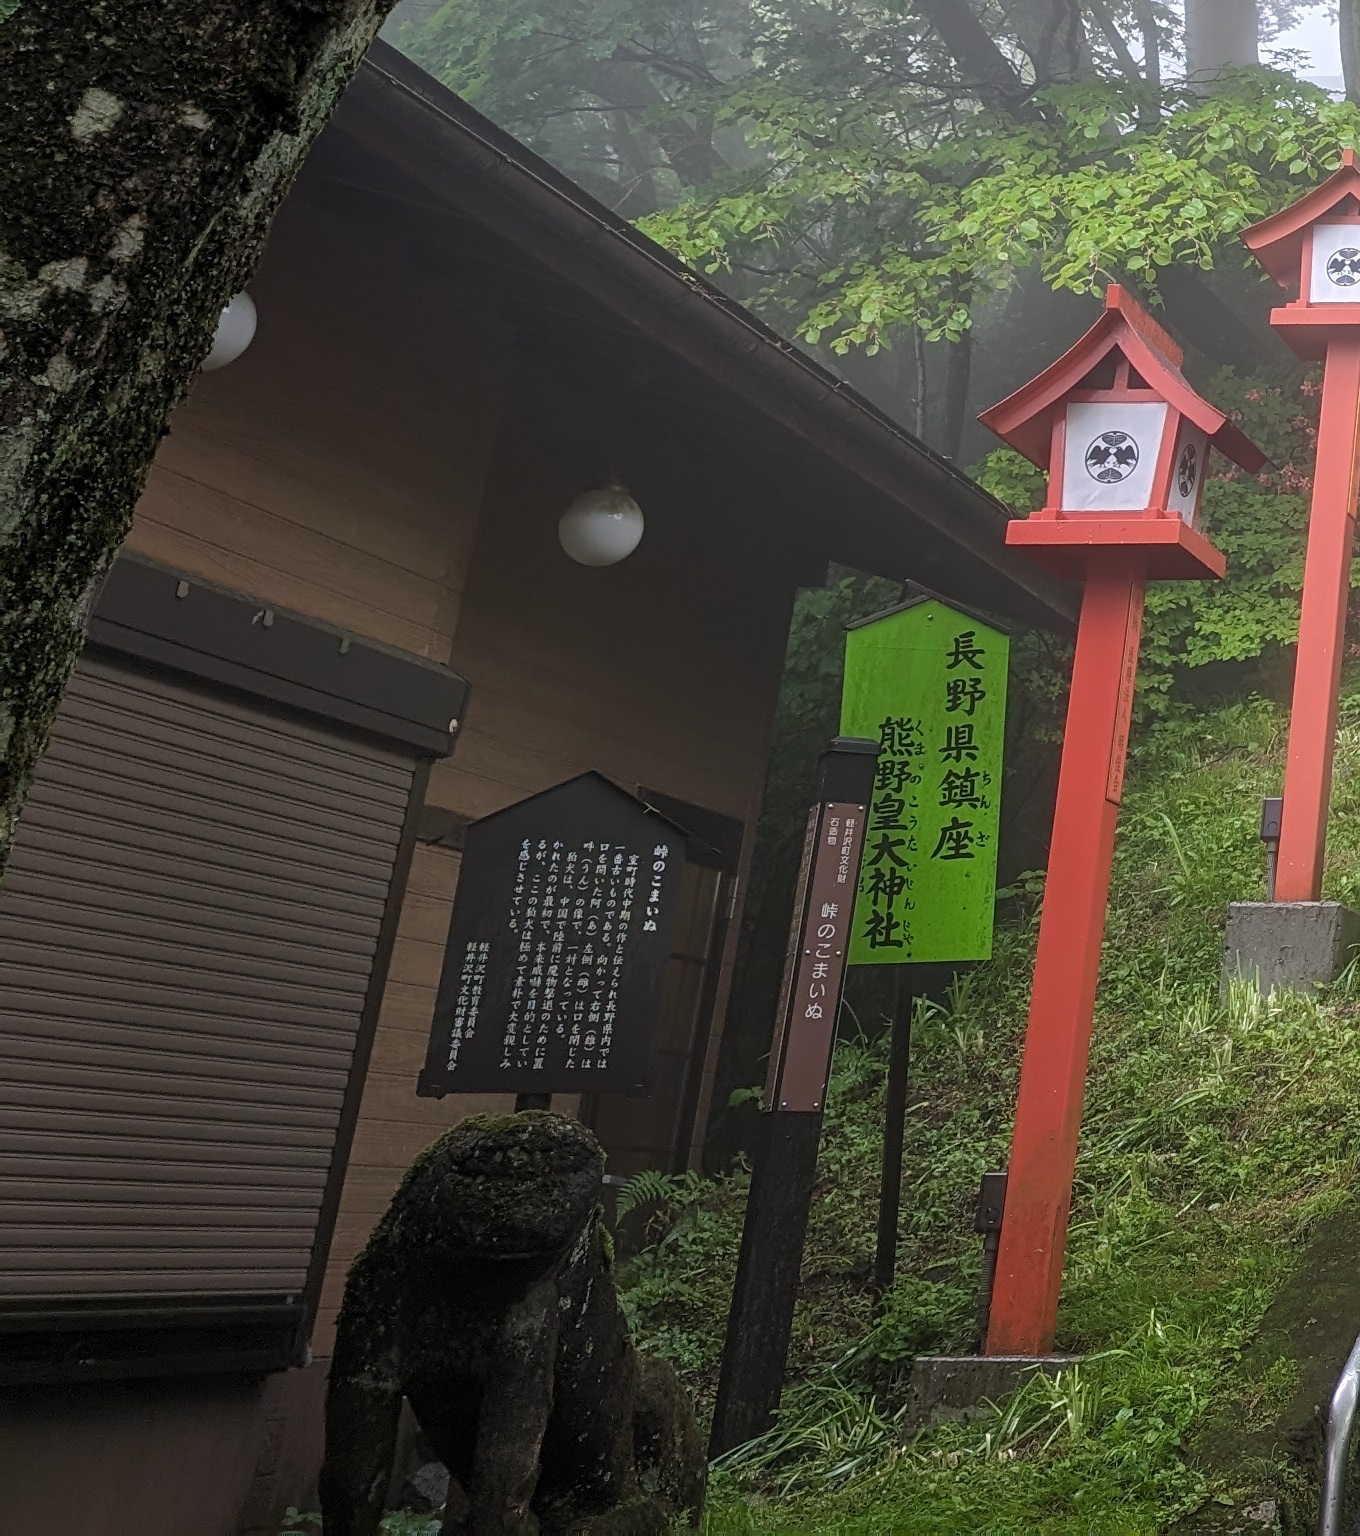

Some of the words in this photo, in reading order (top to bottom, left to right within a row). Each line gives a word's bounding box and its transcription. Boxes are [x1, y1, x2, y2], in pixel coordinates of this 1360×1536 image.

[930, 630, 986, 861] 長野県鎮座
[836, 818, 855, 884] 軽井沢町文化財
[860, 715, 916, 949] 熊野皇大神社
[508, 838, 532, 933] を感じさせている。
[642, 844, 669, 932] 峠のこまいぬ
[464, 942, 490, 1039] 軽井沢町教育委員会
[805, 902, 839, 1020] 峠のこまいぬ
